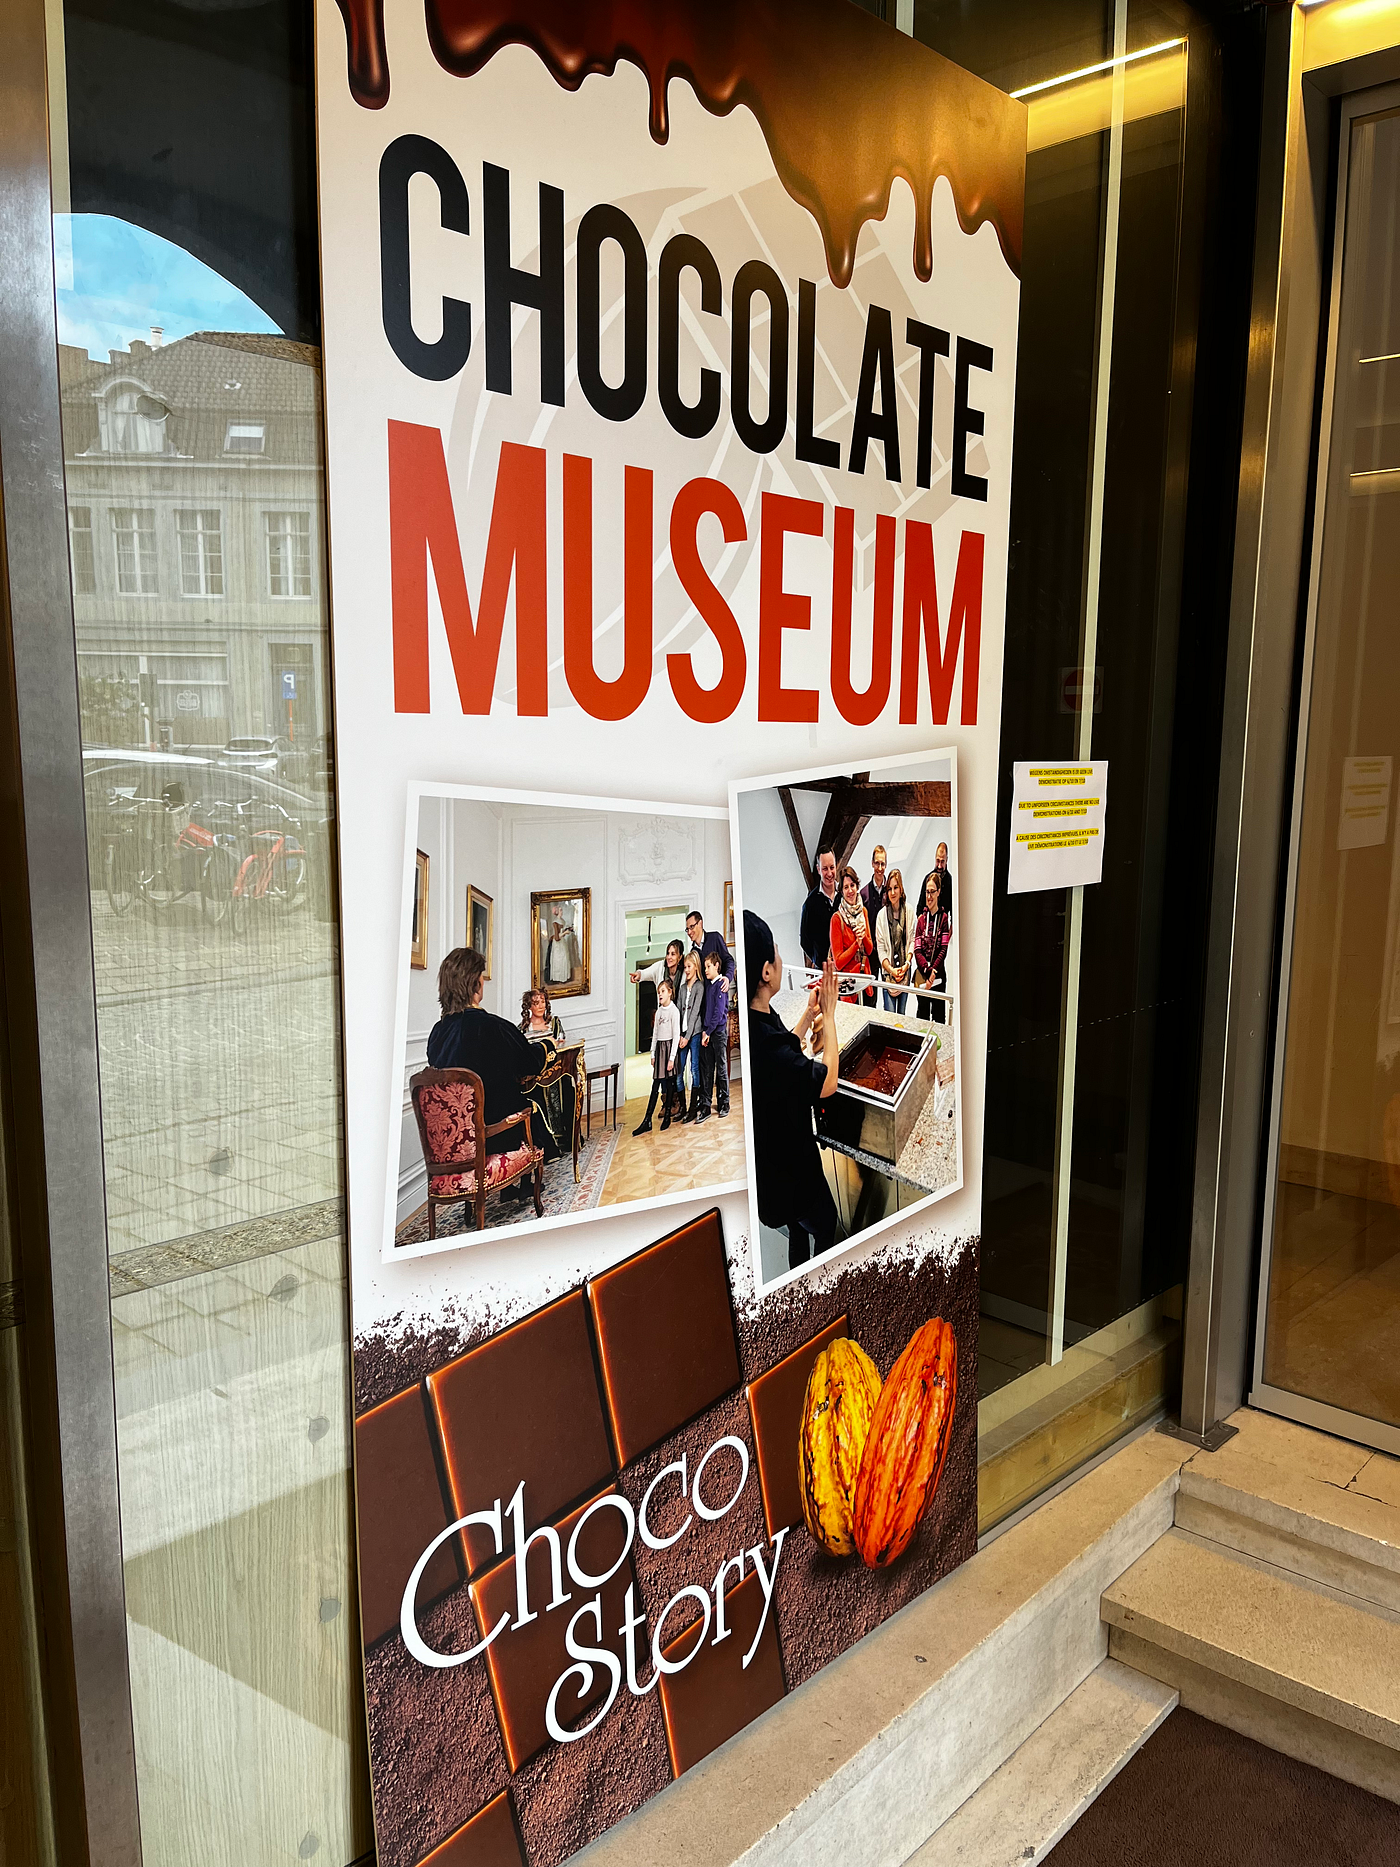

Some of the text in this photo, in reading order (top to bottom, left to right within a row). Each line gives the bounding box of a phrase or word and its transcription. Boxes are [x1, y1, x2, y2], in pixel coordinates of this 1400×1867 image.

[378, 134, 995, 503] CHOCOLATE
[387, 418, 986, 727] MUSEUM
[400, 1435, 750, 1668] Choco
[545, 1526, 790, 1744] Story
